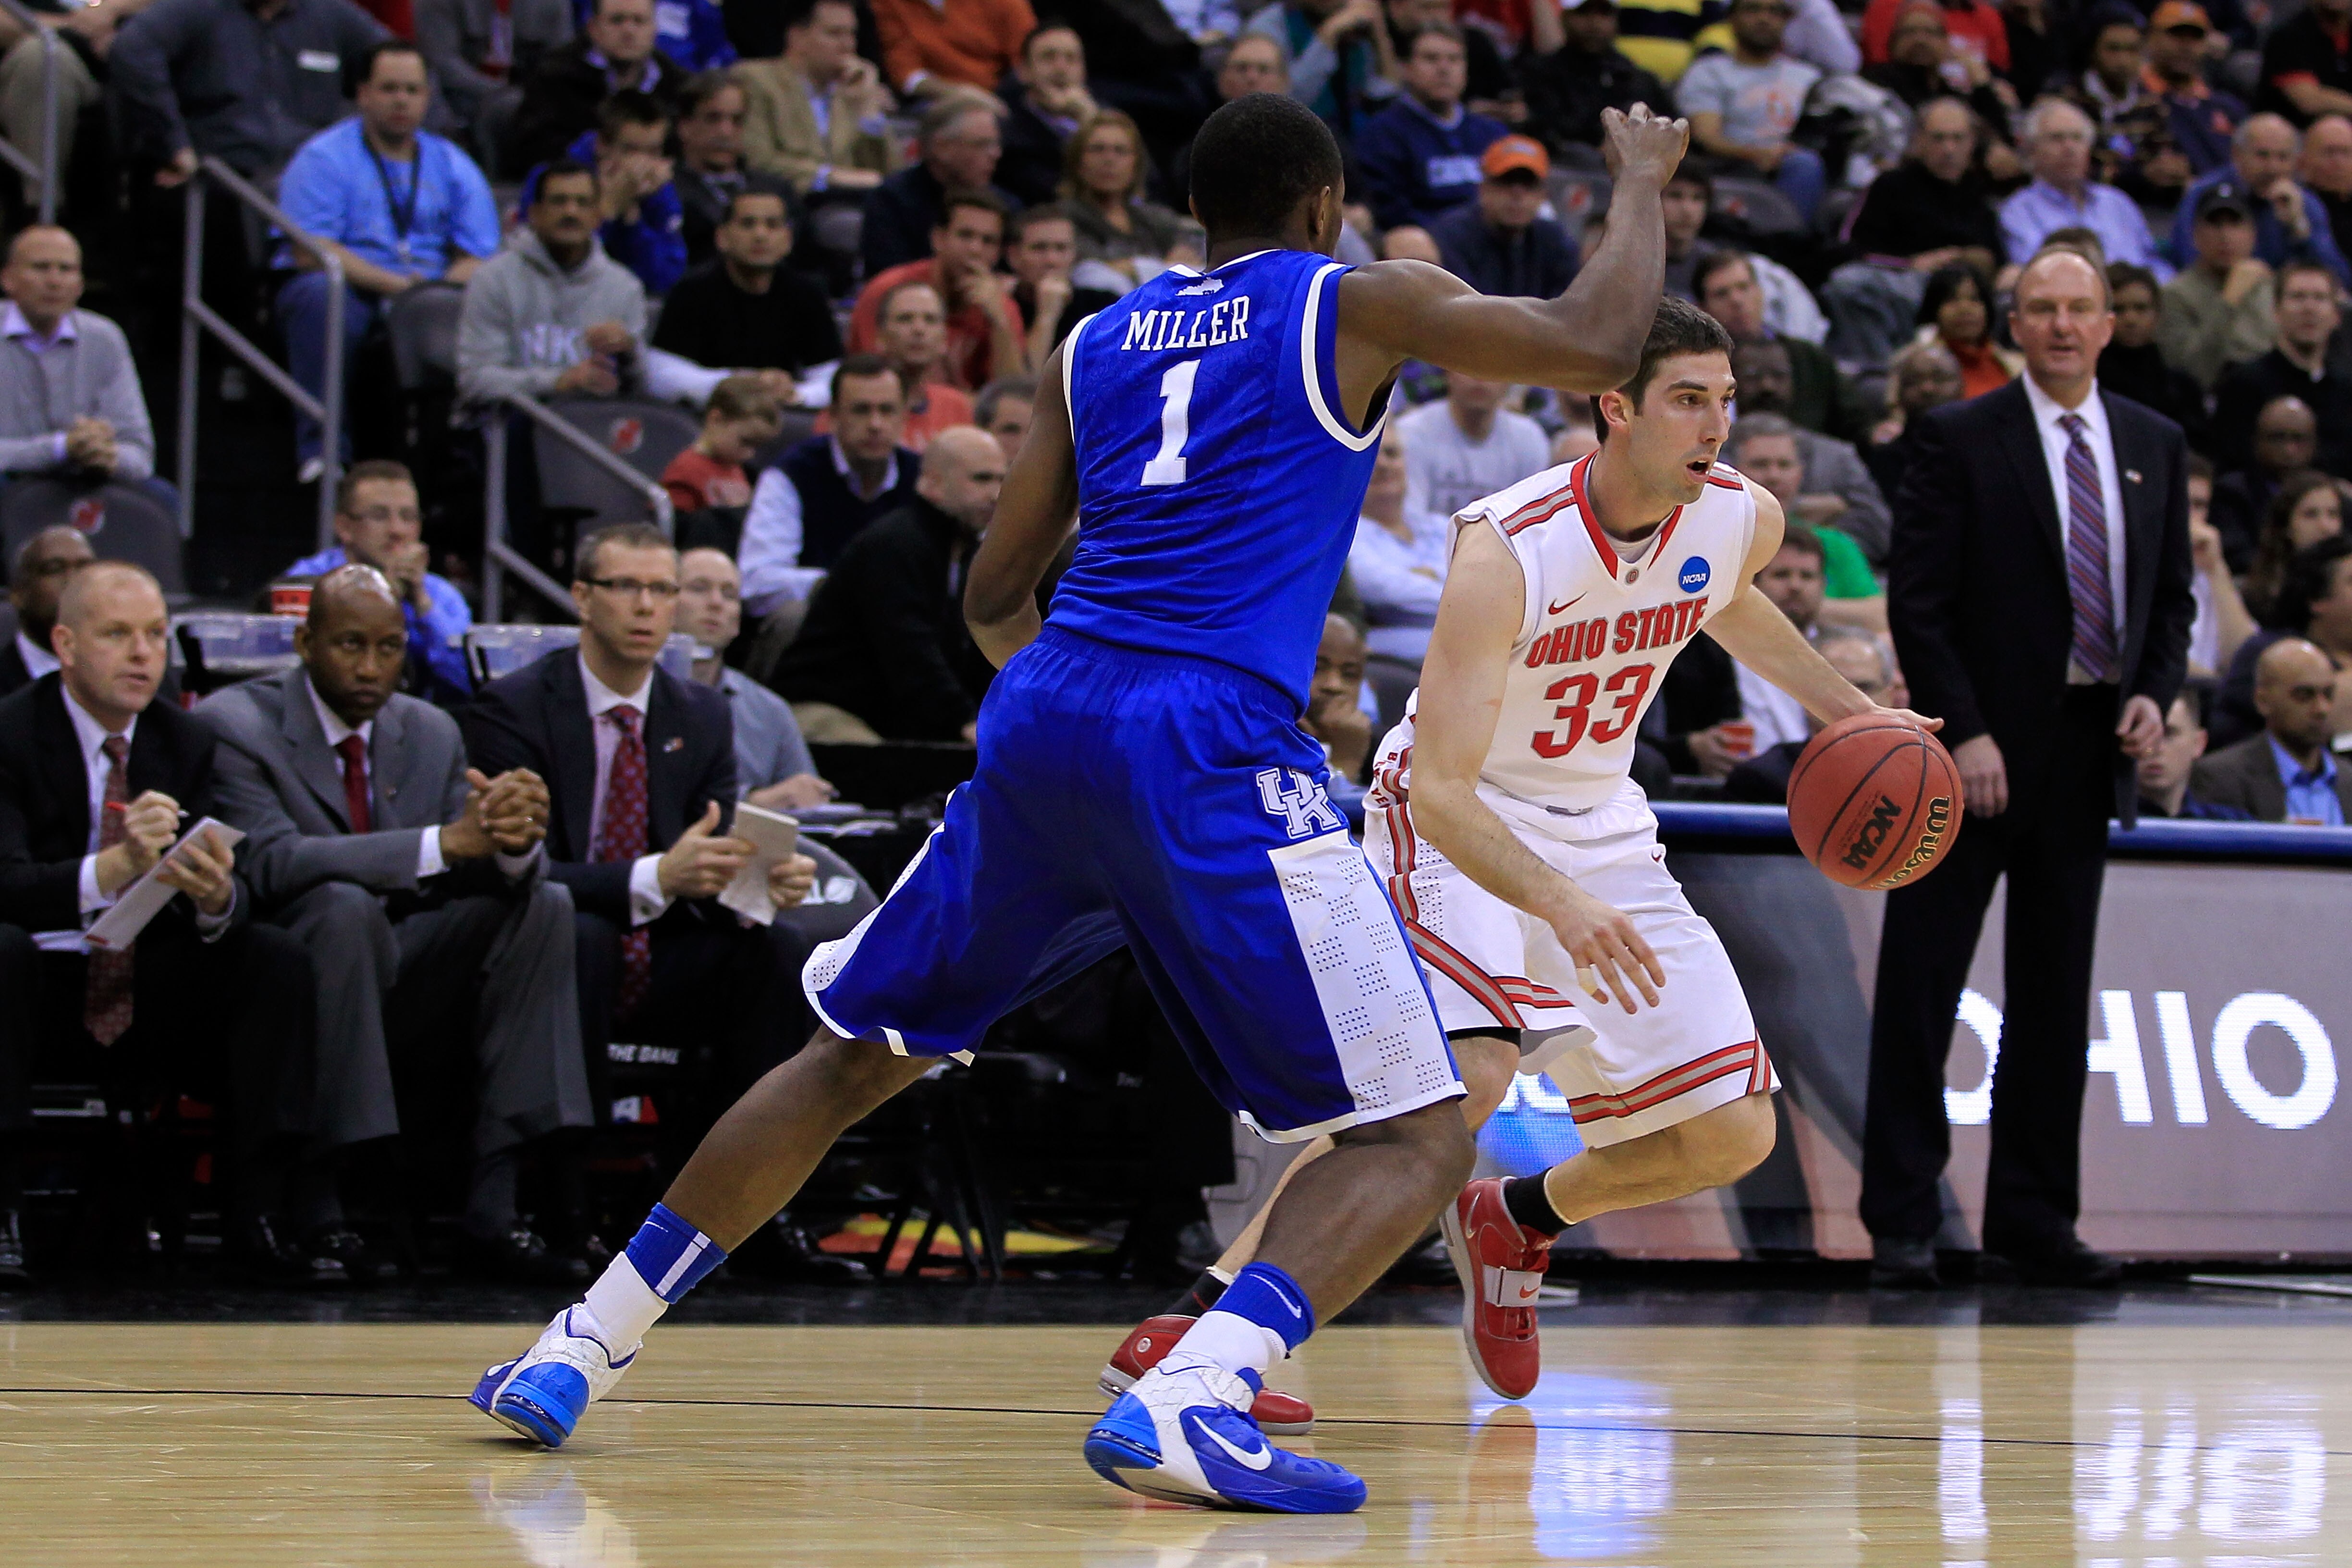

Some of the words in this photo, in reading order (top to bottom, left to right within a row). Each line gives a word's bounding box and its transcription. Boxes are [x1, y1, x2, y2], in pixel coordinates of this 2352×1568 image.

[1121, 295, 1250, 351] MILLER
[1140, 359, 1200, 486] 1
[1682, 573, 1706, 585] NCAA
[1524, 617, 1608, 668] OHIO
[1612, 595, 1709, 655] STATE
[1531, 662, 1655, 758] 33
[1256, 767, 1341, 840] UK
[1841, 795, 1903, 870] NCAA
